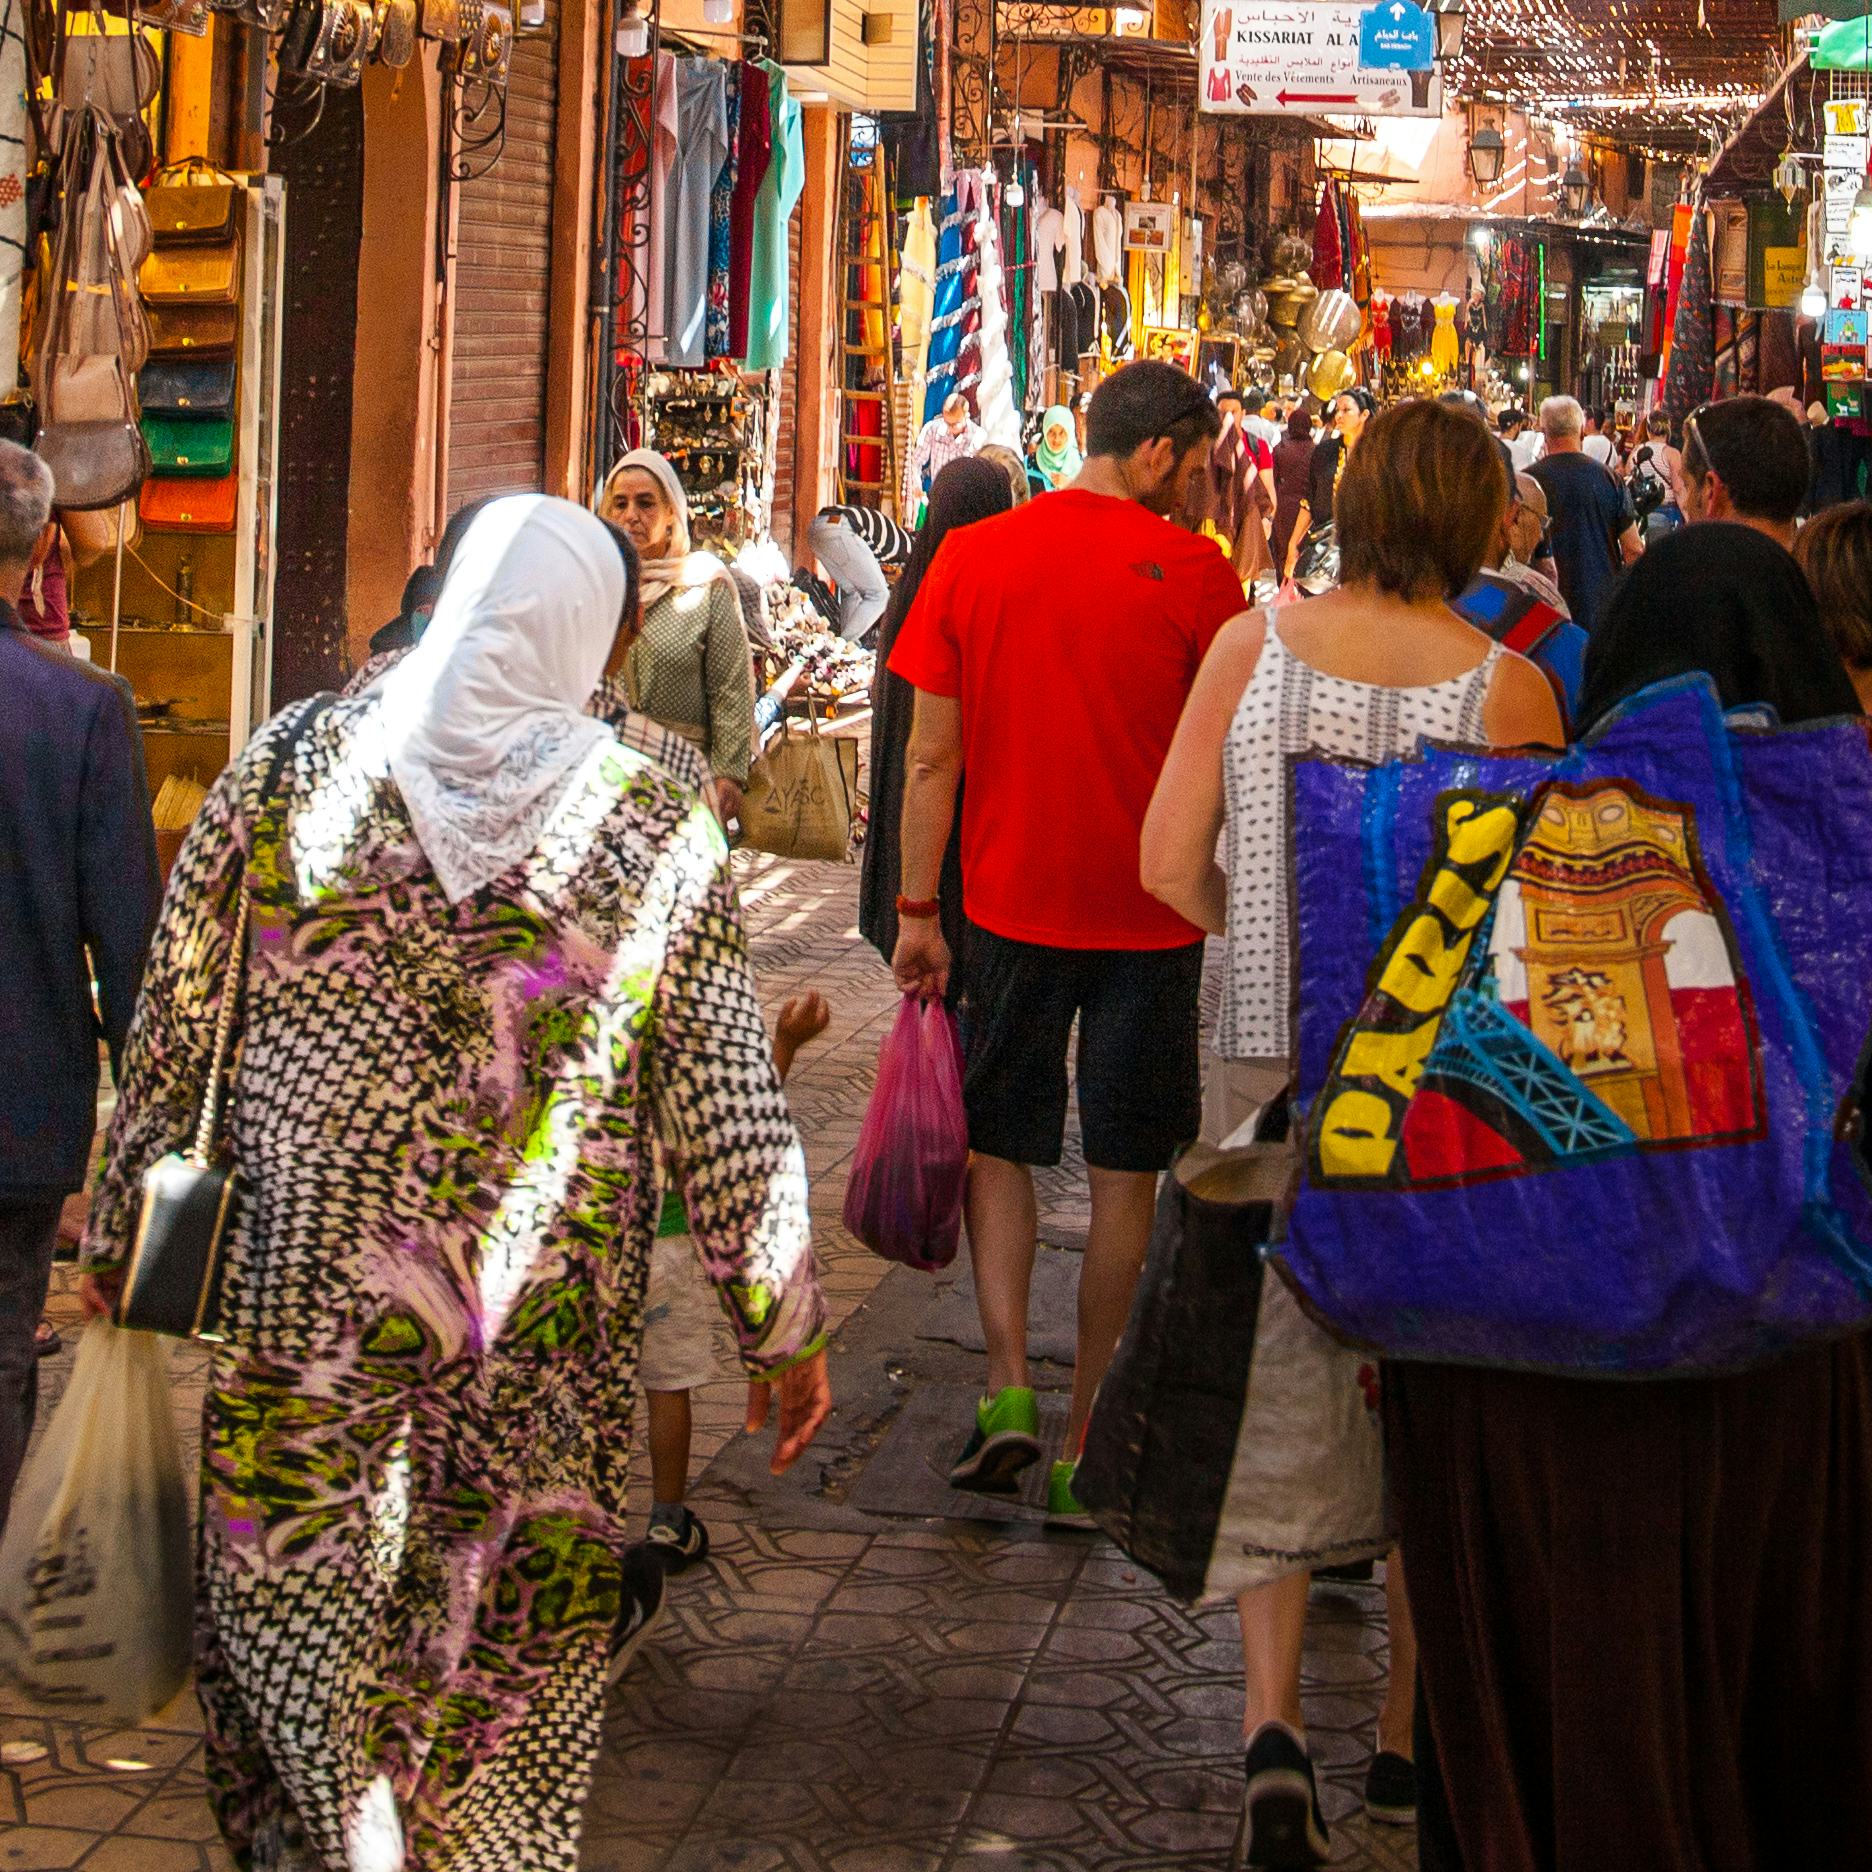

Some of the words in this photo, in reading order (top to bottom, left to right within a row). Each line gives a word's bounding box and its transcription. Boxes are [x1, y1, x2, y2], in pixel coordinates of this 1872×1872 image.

[1236, 29, 1315, 46] KISSARIAT
[1326, 33, 1344, 46] AL
[1235, 70, 1262, 83] Vente
[1265, 71, 1281, 84] des
[1284, 71, 1335, 86] Vêtements
[1319, 799, 1518, 1176] PARIS
